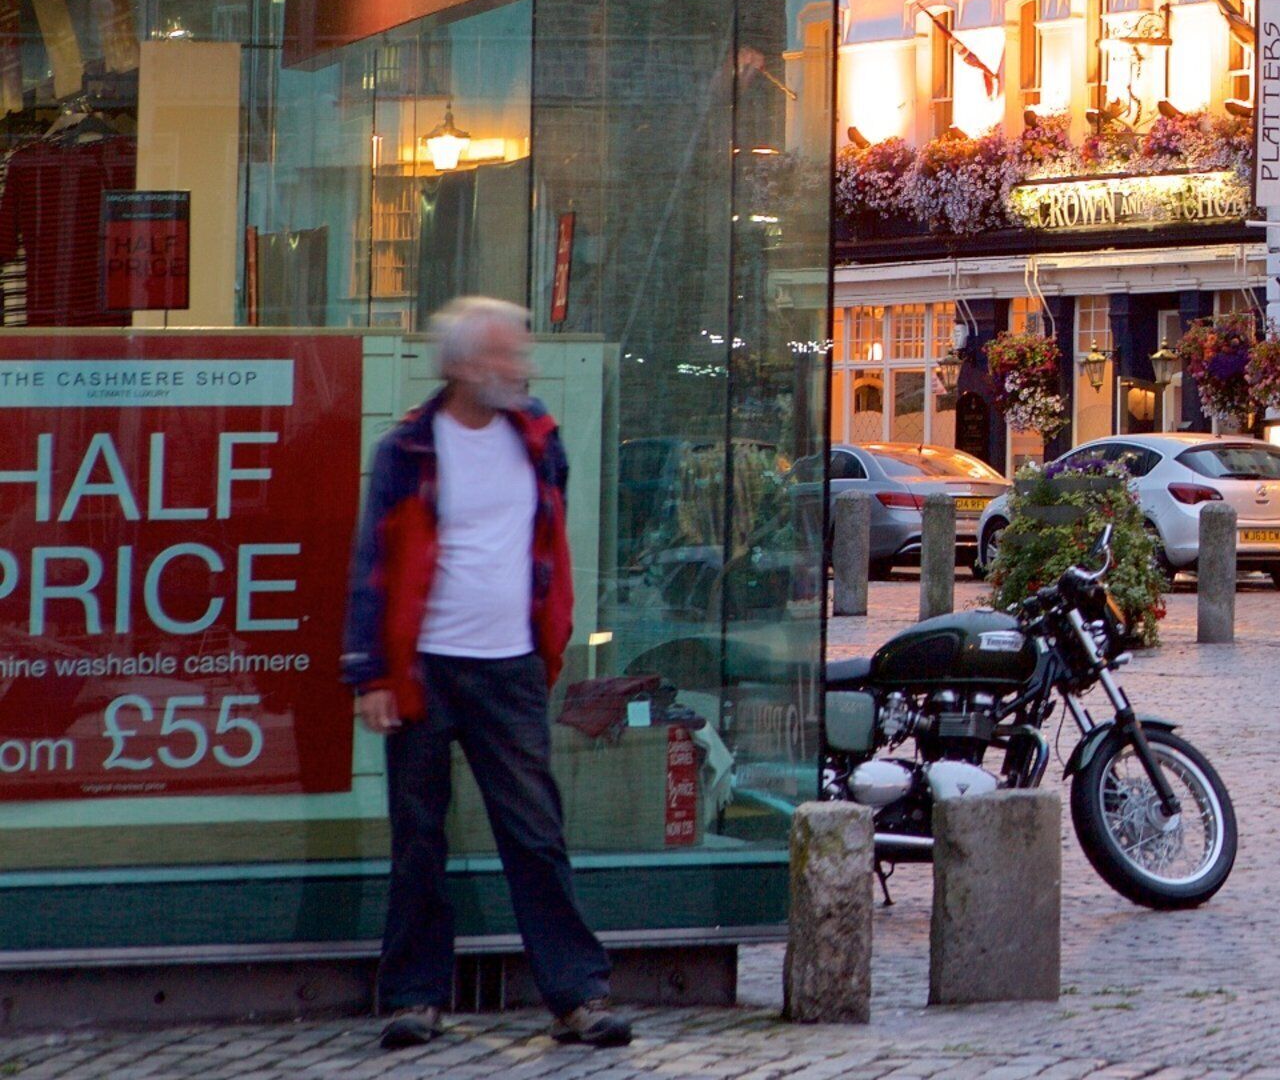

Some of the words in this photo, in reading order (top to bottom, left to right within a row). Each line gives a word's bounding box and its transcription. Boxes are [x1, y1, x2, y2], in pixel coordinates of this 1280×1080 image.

[1261, 22, 1280, 181] PLATTERS
[114, 235, 178, 255] HALF
[108, 257, 188, 277] PRICE
[3, 371, 44, 387] THE
[57, 371, 184, 387] CASHMERE
[195, 370, 258, 386] SHOP
[54, 652, 176, 677] washable
[184, 651, 310, 674] cashmere
[102, 693, 264, 770] £55
